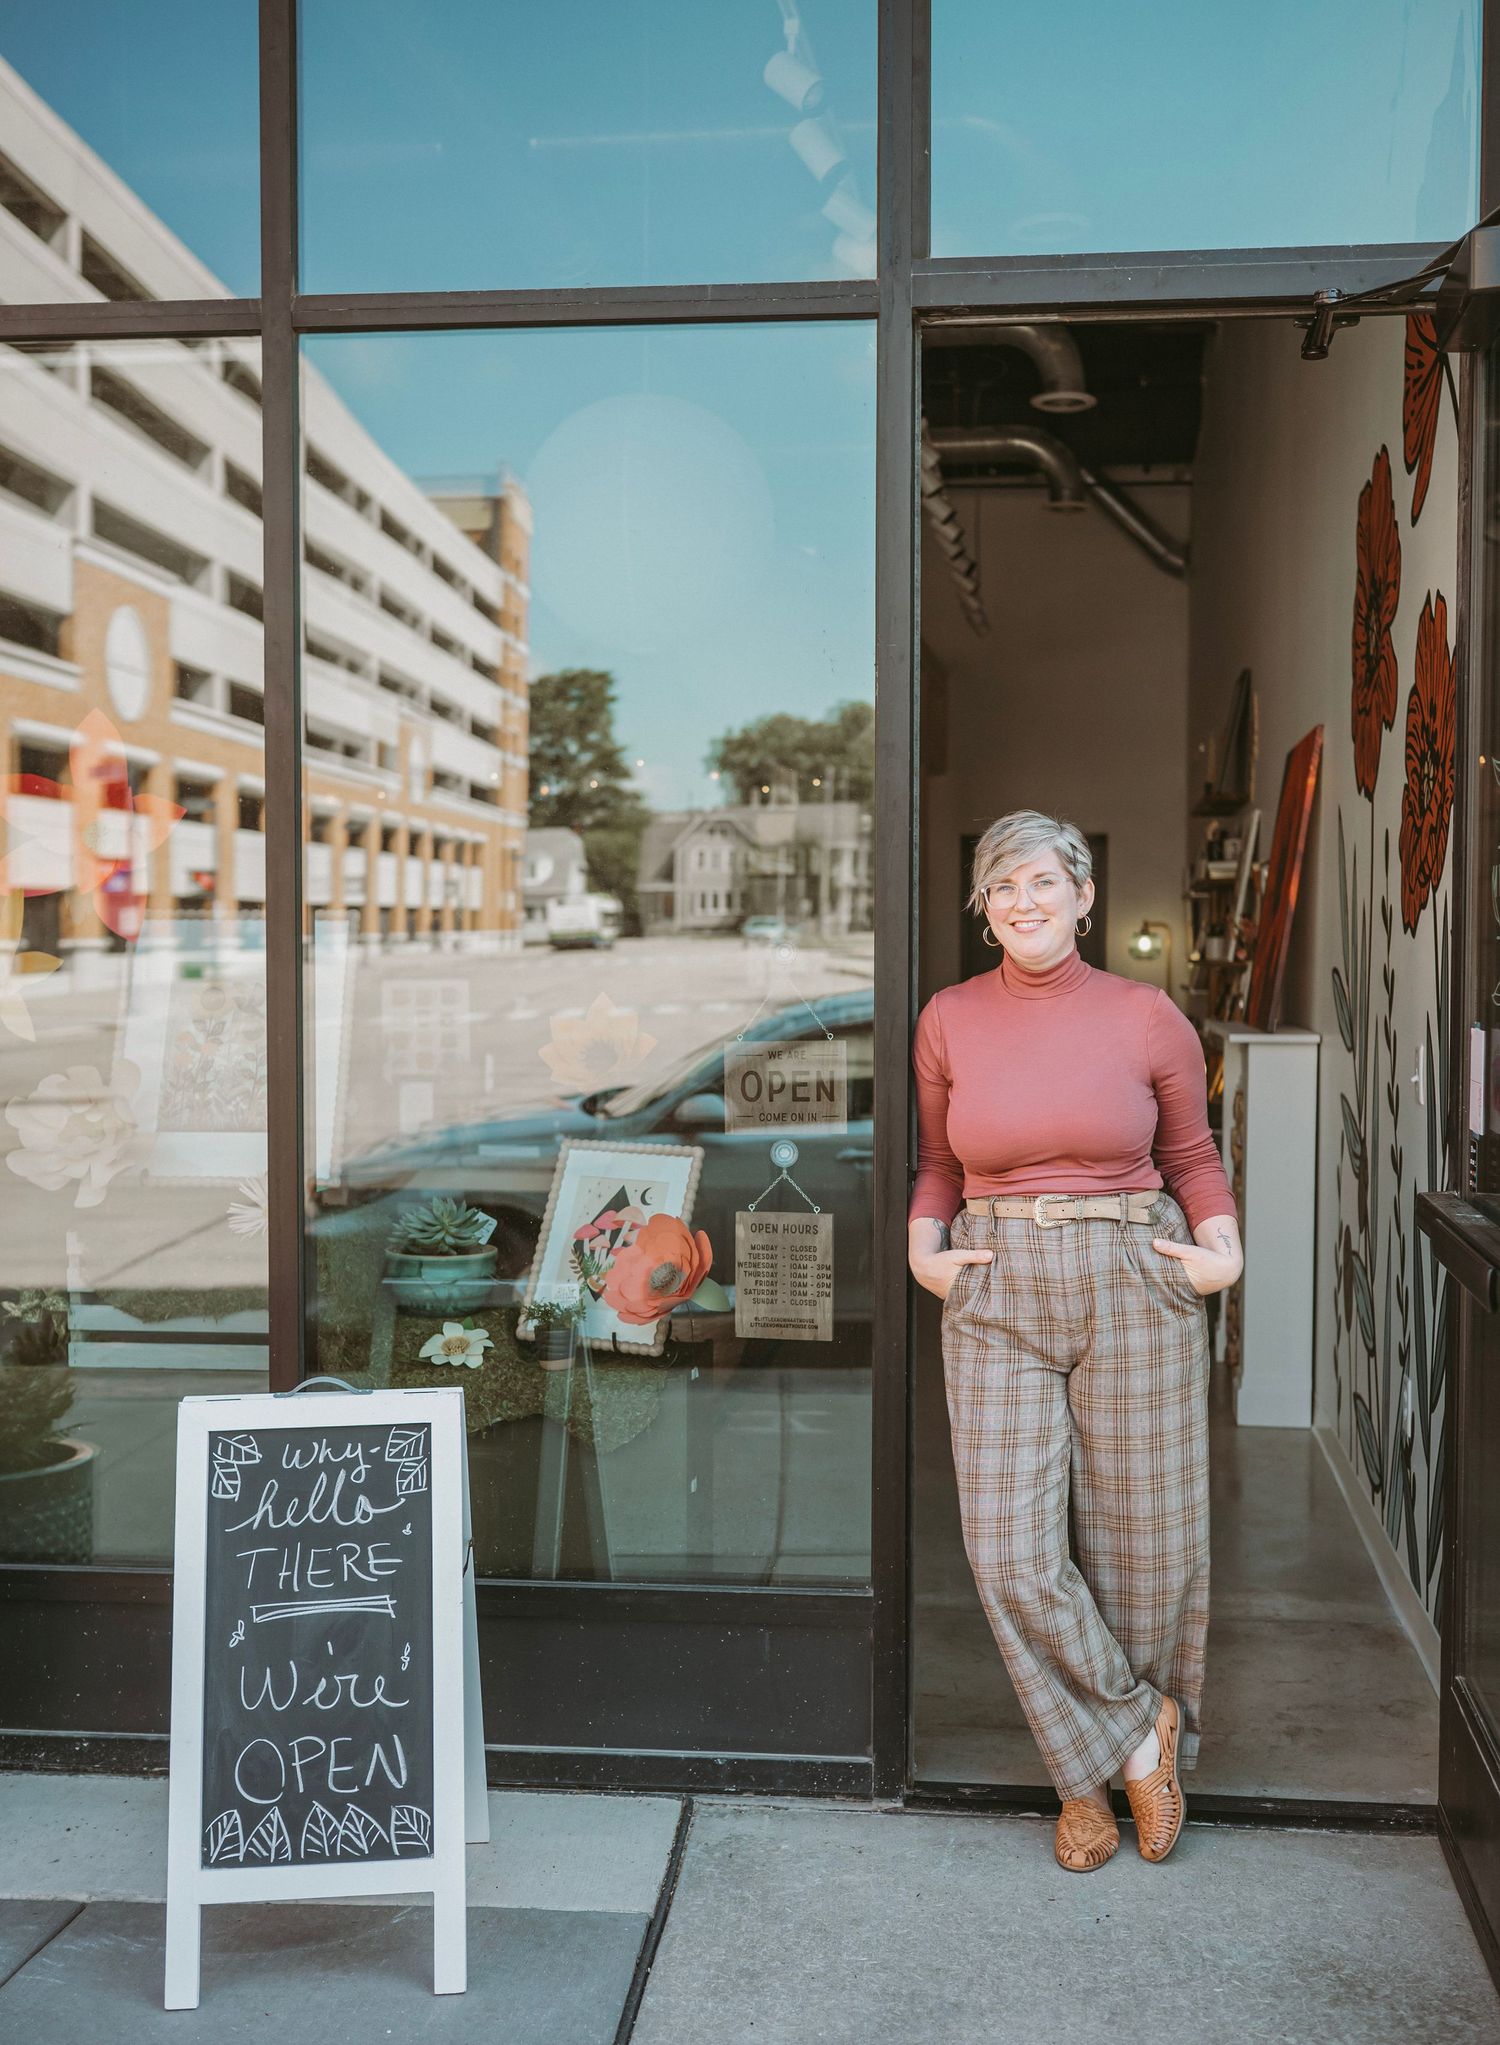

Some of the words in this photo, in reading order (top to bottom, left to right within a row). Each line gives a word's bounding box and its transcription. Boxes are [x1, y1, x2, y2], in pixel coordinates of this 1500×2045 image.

[767, 1050, 783, 1060] WE
[787, 1050, 807, 1060] ARE
[740, 1070, 835, 1103] OPEN
[759, 1112, 787, 1122] COME
[790, 1112, 804, 1122] ON
[807, 1112, 817, 1122] IN
[750, 1222, 778, 1234] OPEN
[782, 1223, 819, 1235] HOURS
[790, 1245, 818, 1253] CLOSED
[790, 1254, 818, 1262] CLOSED
[737, 1261, 778, 1269] WEDNESDAY
[743, 1270, 778, 1278] THURSDAY
[225, 1468, 406, 1531] hello
[236, 1542, 403, 1592] THERE
[235, 1734, 408, 1804] OPEN
